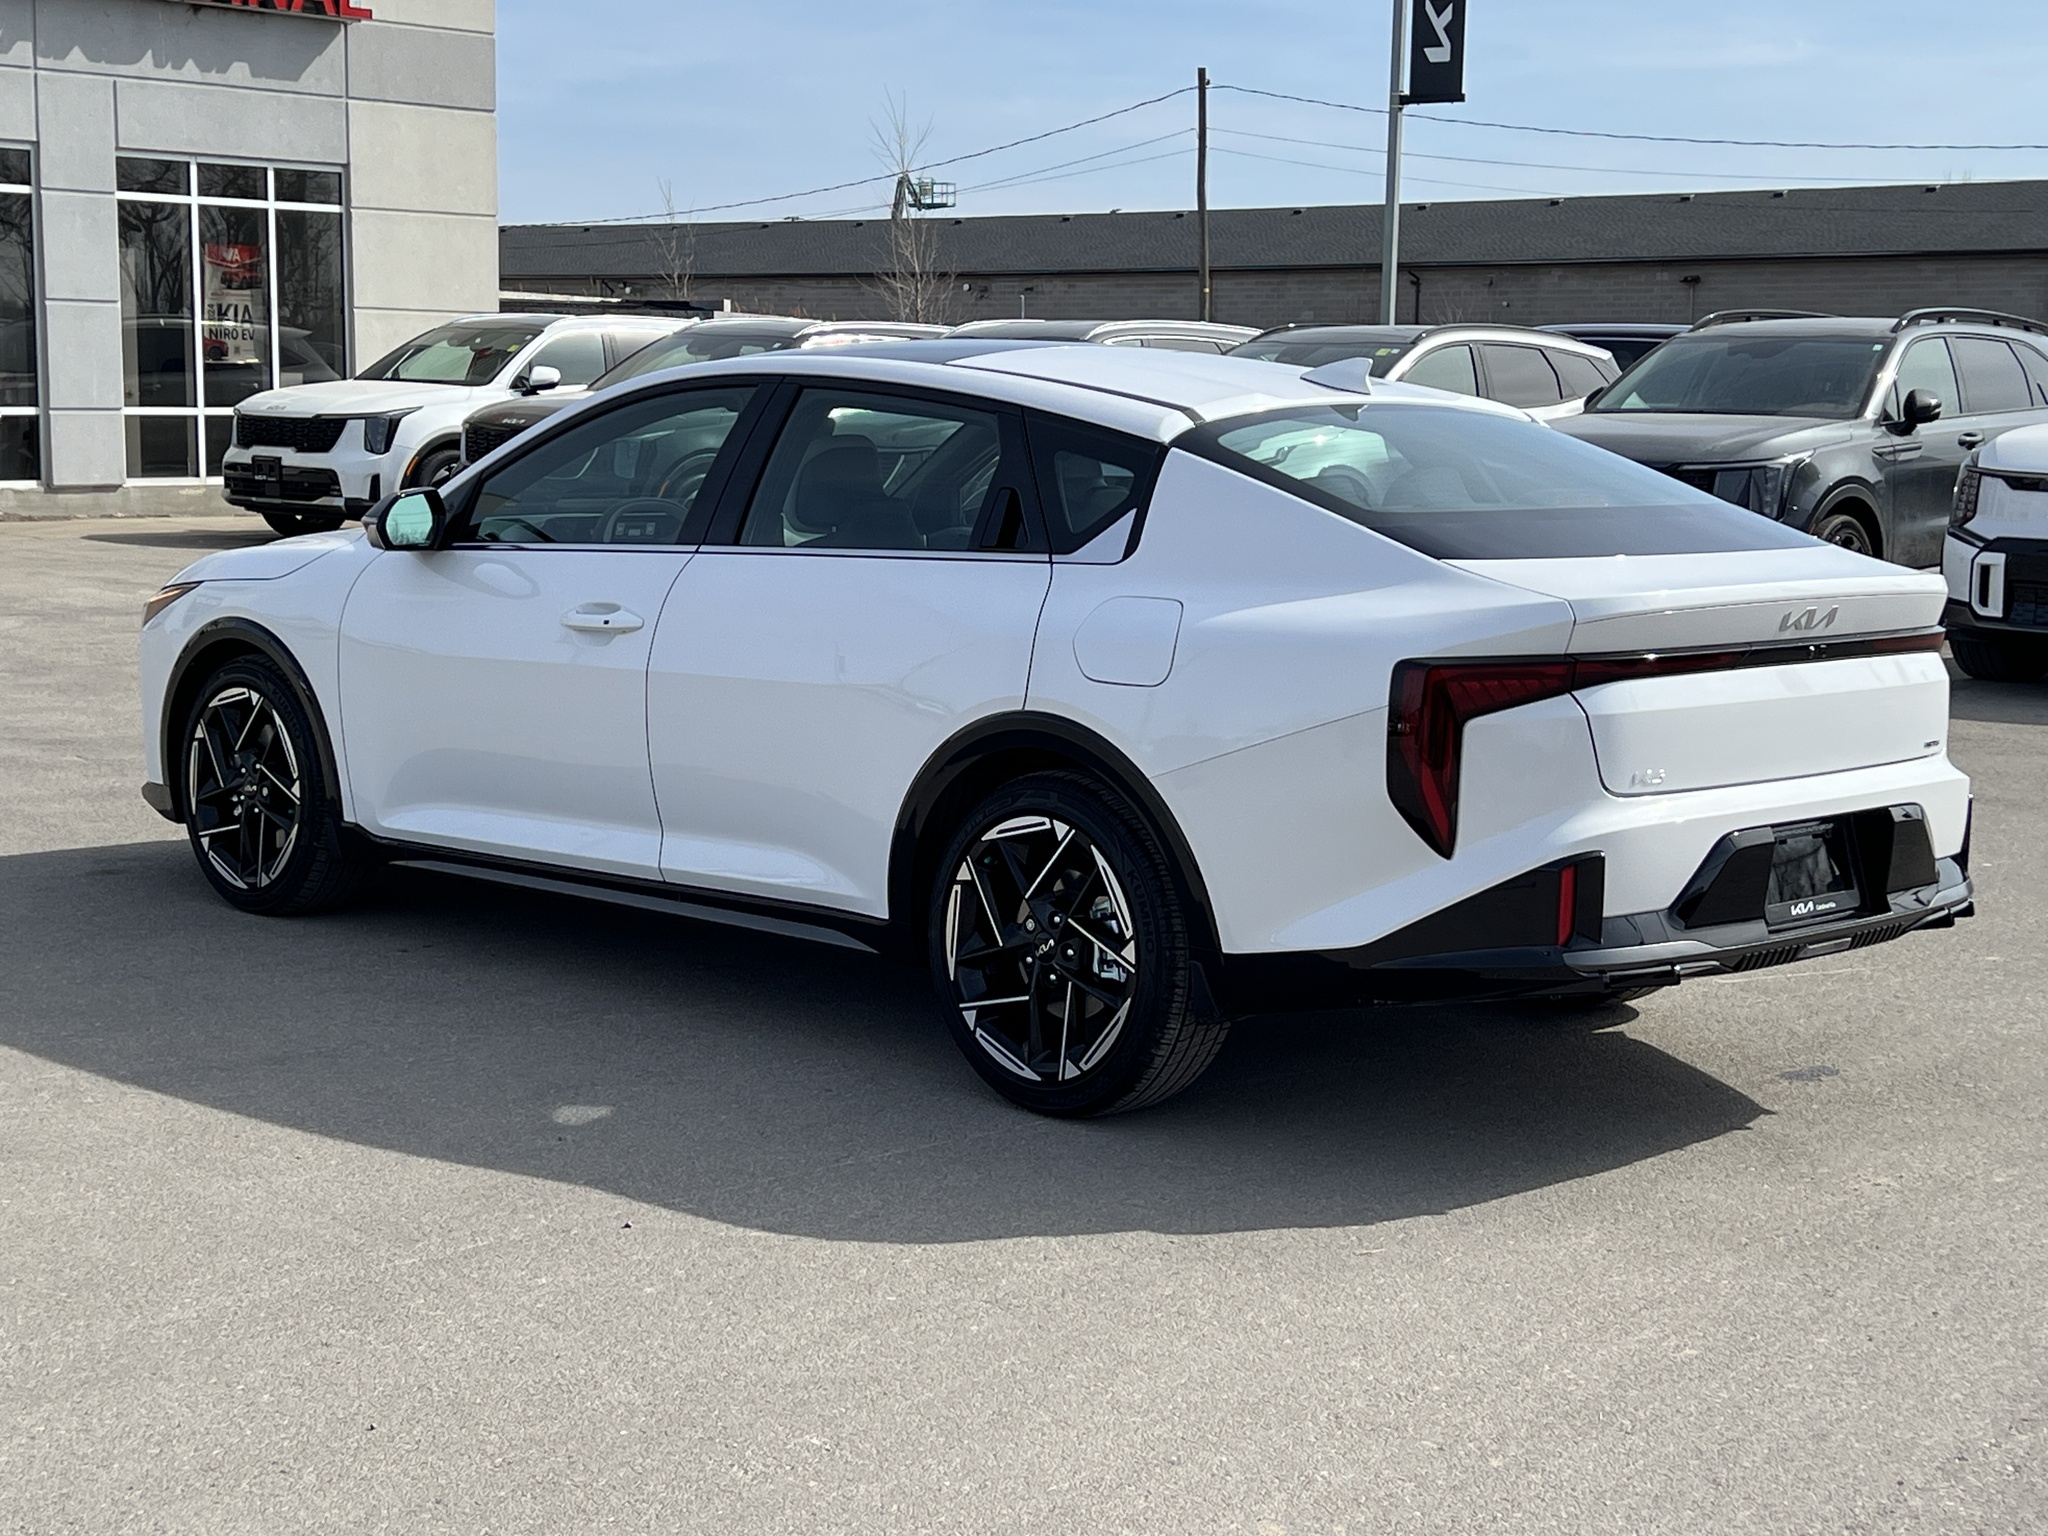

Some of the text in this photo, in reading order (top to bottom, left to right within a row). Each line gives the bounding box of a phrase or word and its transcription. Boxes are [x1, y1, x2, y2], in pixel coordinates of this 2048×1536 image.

[216, 303, 254, 324] KIA
[208, 328, 256, 341] NIRO EV
[1778, 604, 1839, 632] KIA
[1127, 868, 1156, 954] KUMHO
[1790, 901, 1814, 915] KIA
